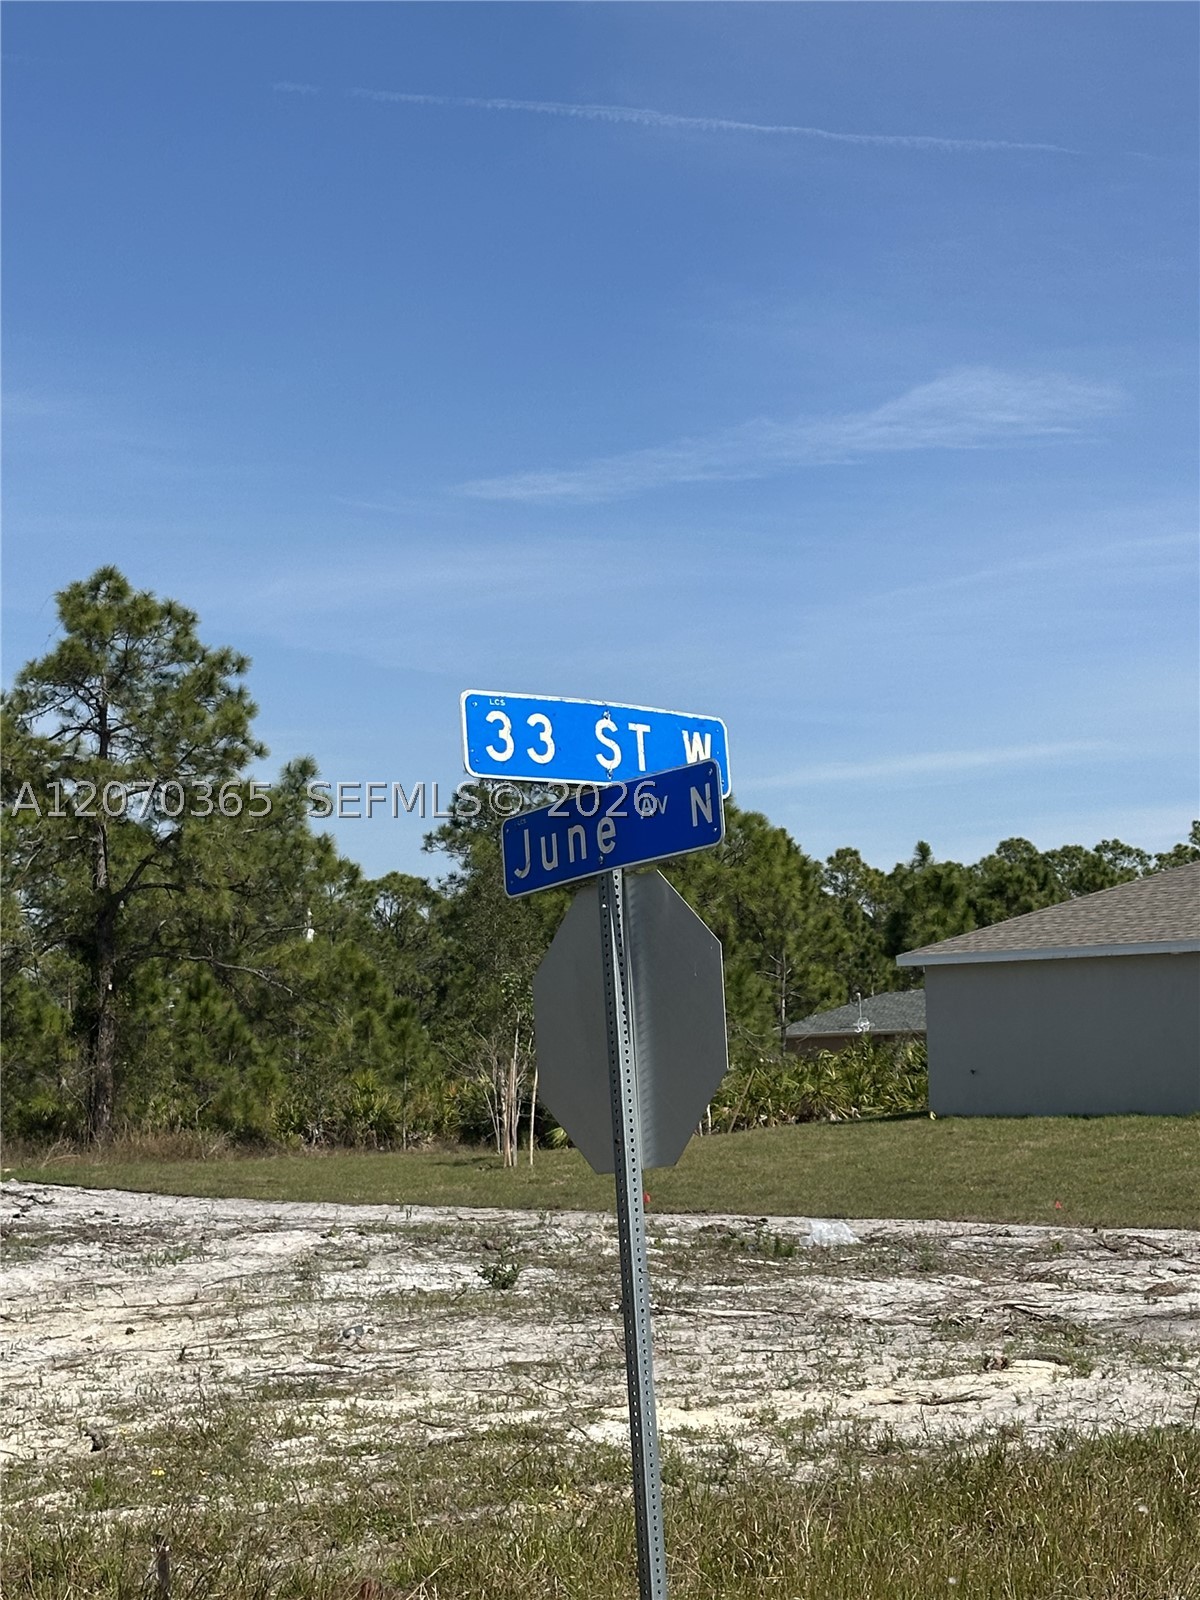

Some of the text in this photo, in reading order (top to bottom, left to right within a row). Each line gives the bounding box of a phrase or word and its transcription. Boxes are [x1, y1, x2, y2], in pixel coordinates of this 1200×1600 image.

[489, 698, 506, 706] LCS
[485, 710, 711, 771] 33 ST W
[514, 782, 713, 879] June AV N
